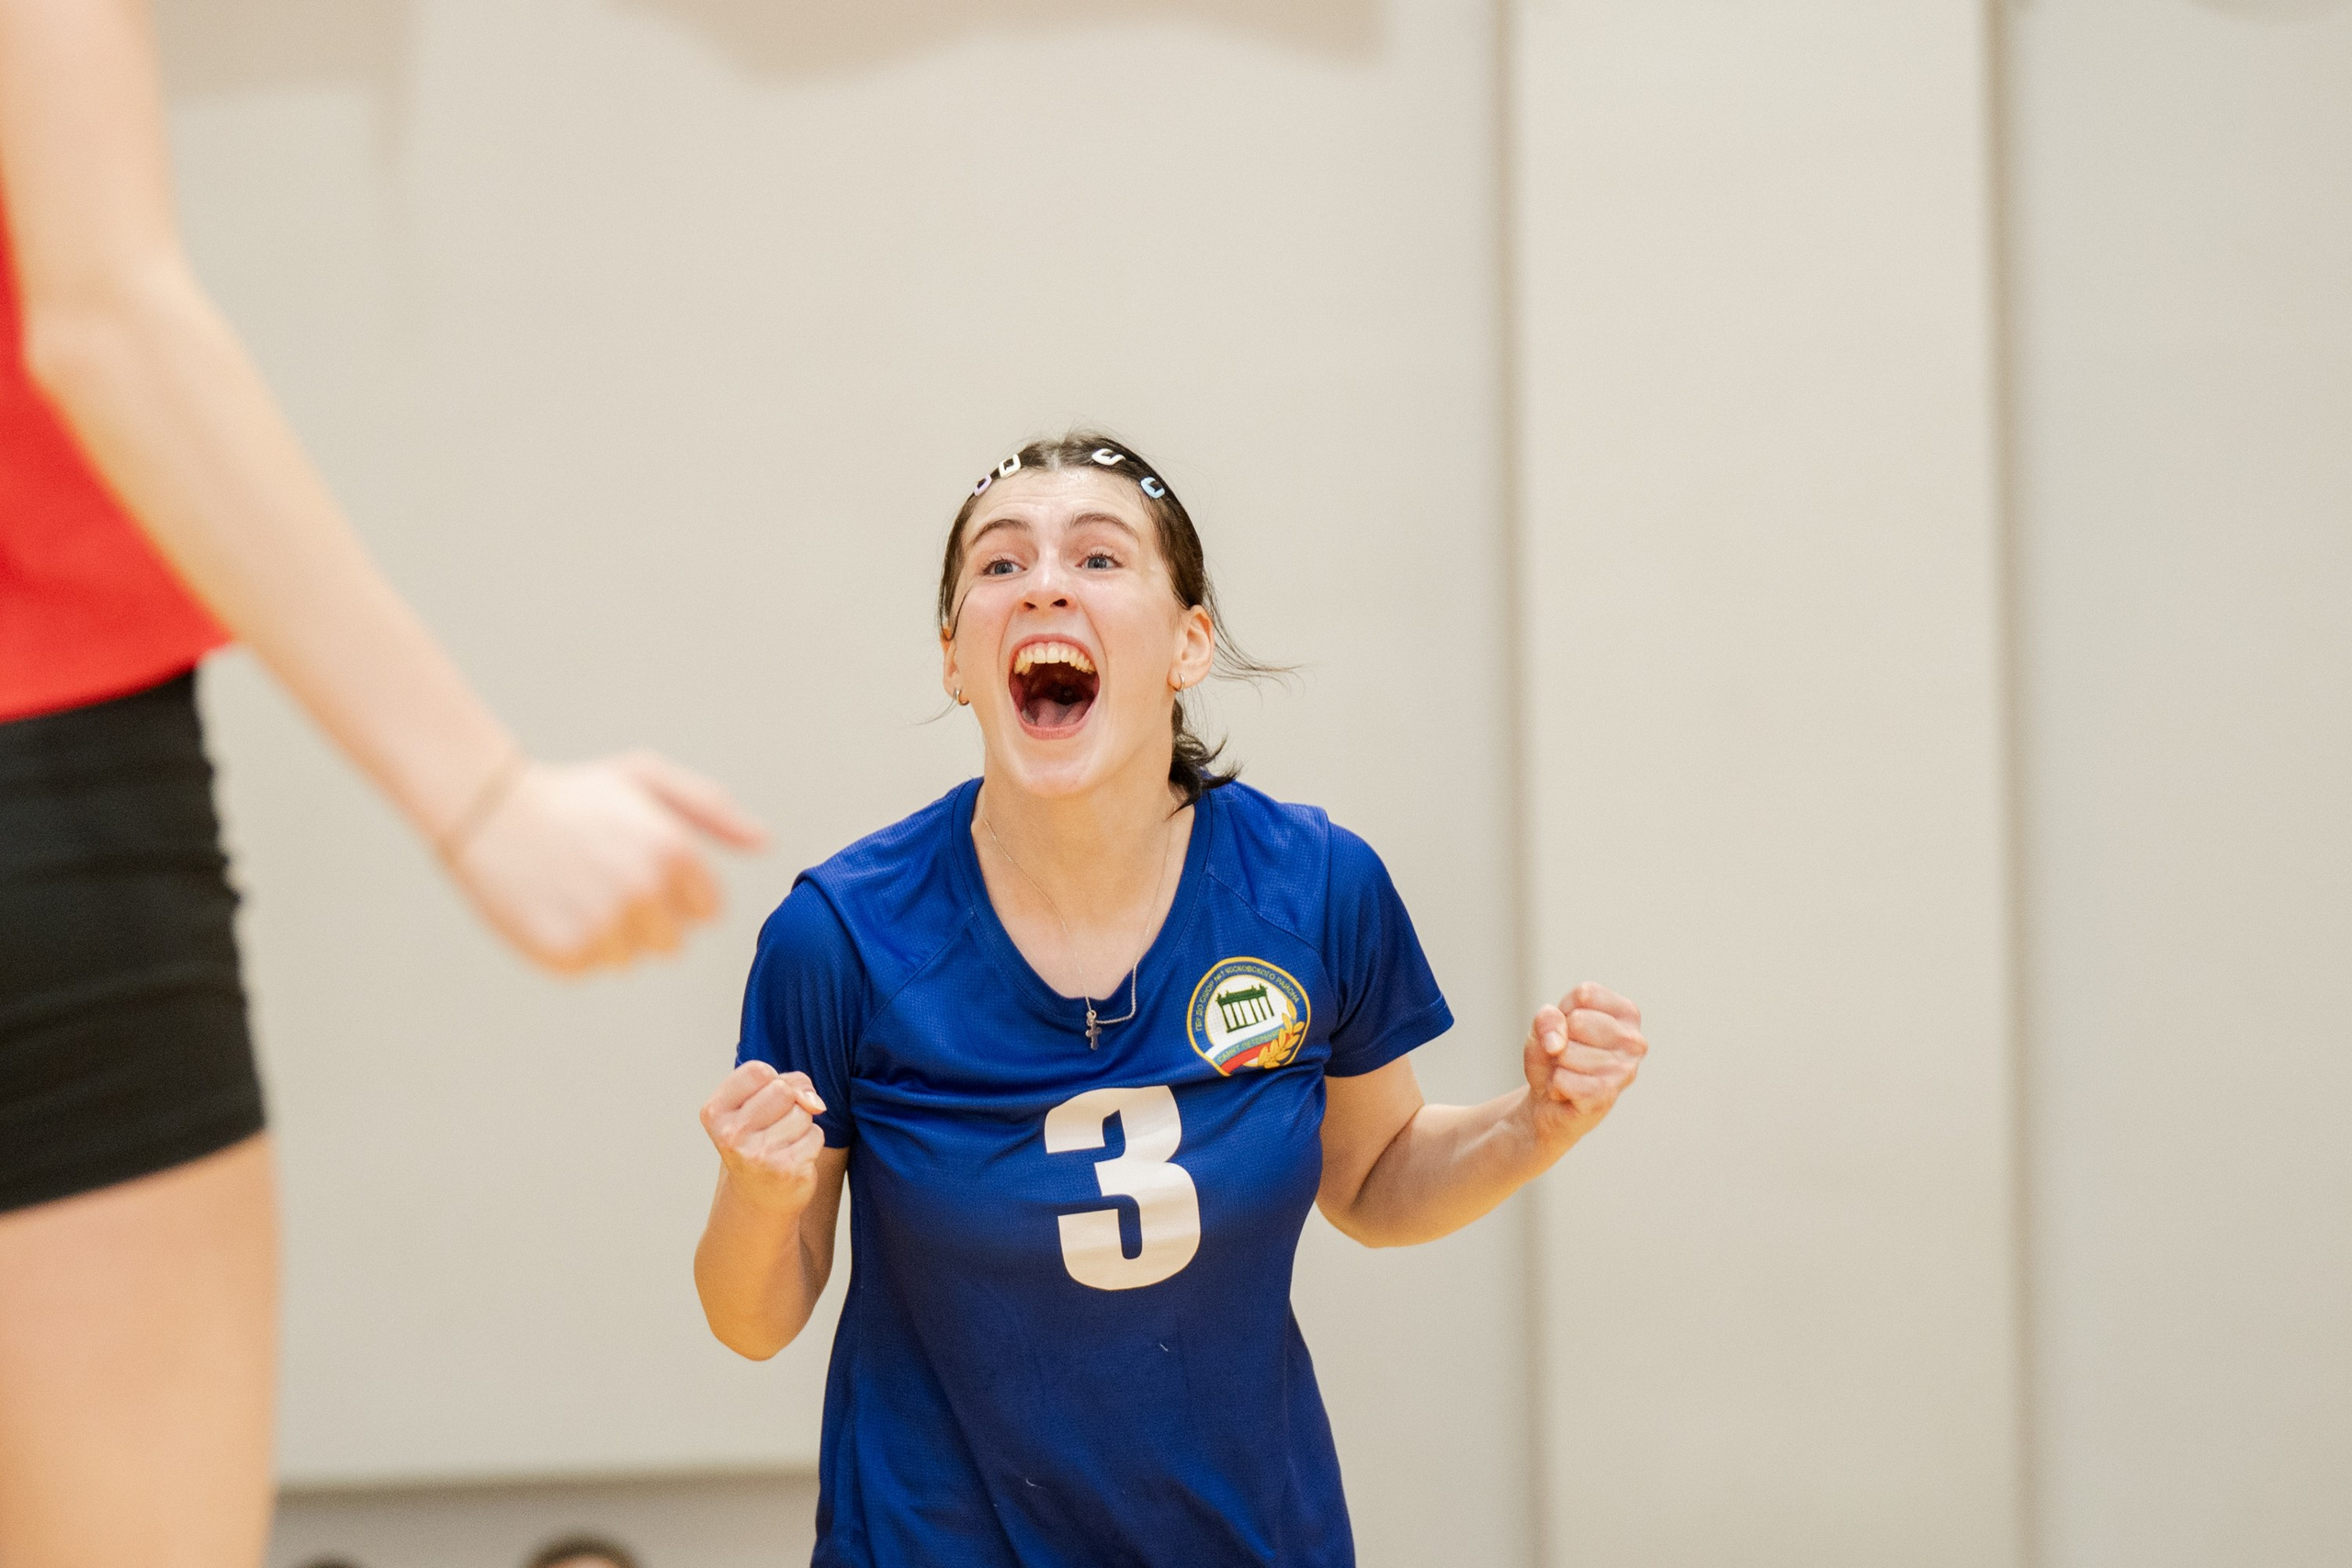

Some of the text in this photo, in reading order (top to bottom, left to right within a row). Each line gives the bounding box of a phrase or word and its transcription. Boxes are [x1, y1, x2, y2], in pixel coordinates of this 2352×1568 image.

[1195, 1004, 1204, 1016] ДО
[1200, 981, 1214, 1002] СШОР
[1226, 965, 1275, 979] МОСКОВСКОГО
[1276, 977, 1299, 1003] РАЙОНА
[1045, 1085, 1201, 1291] 3
